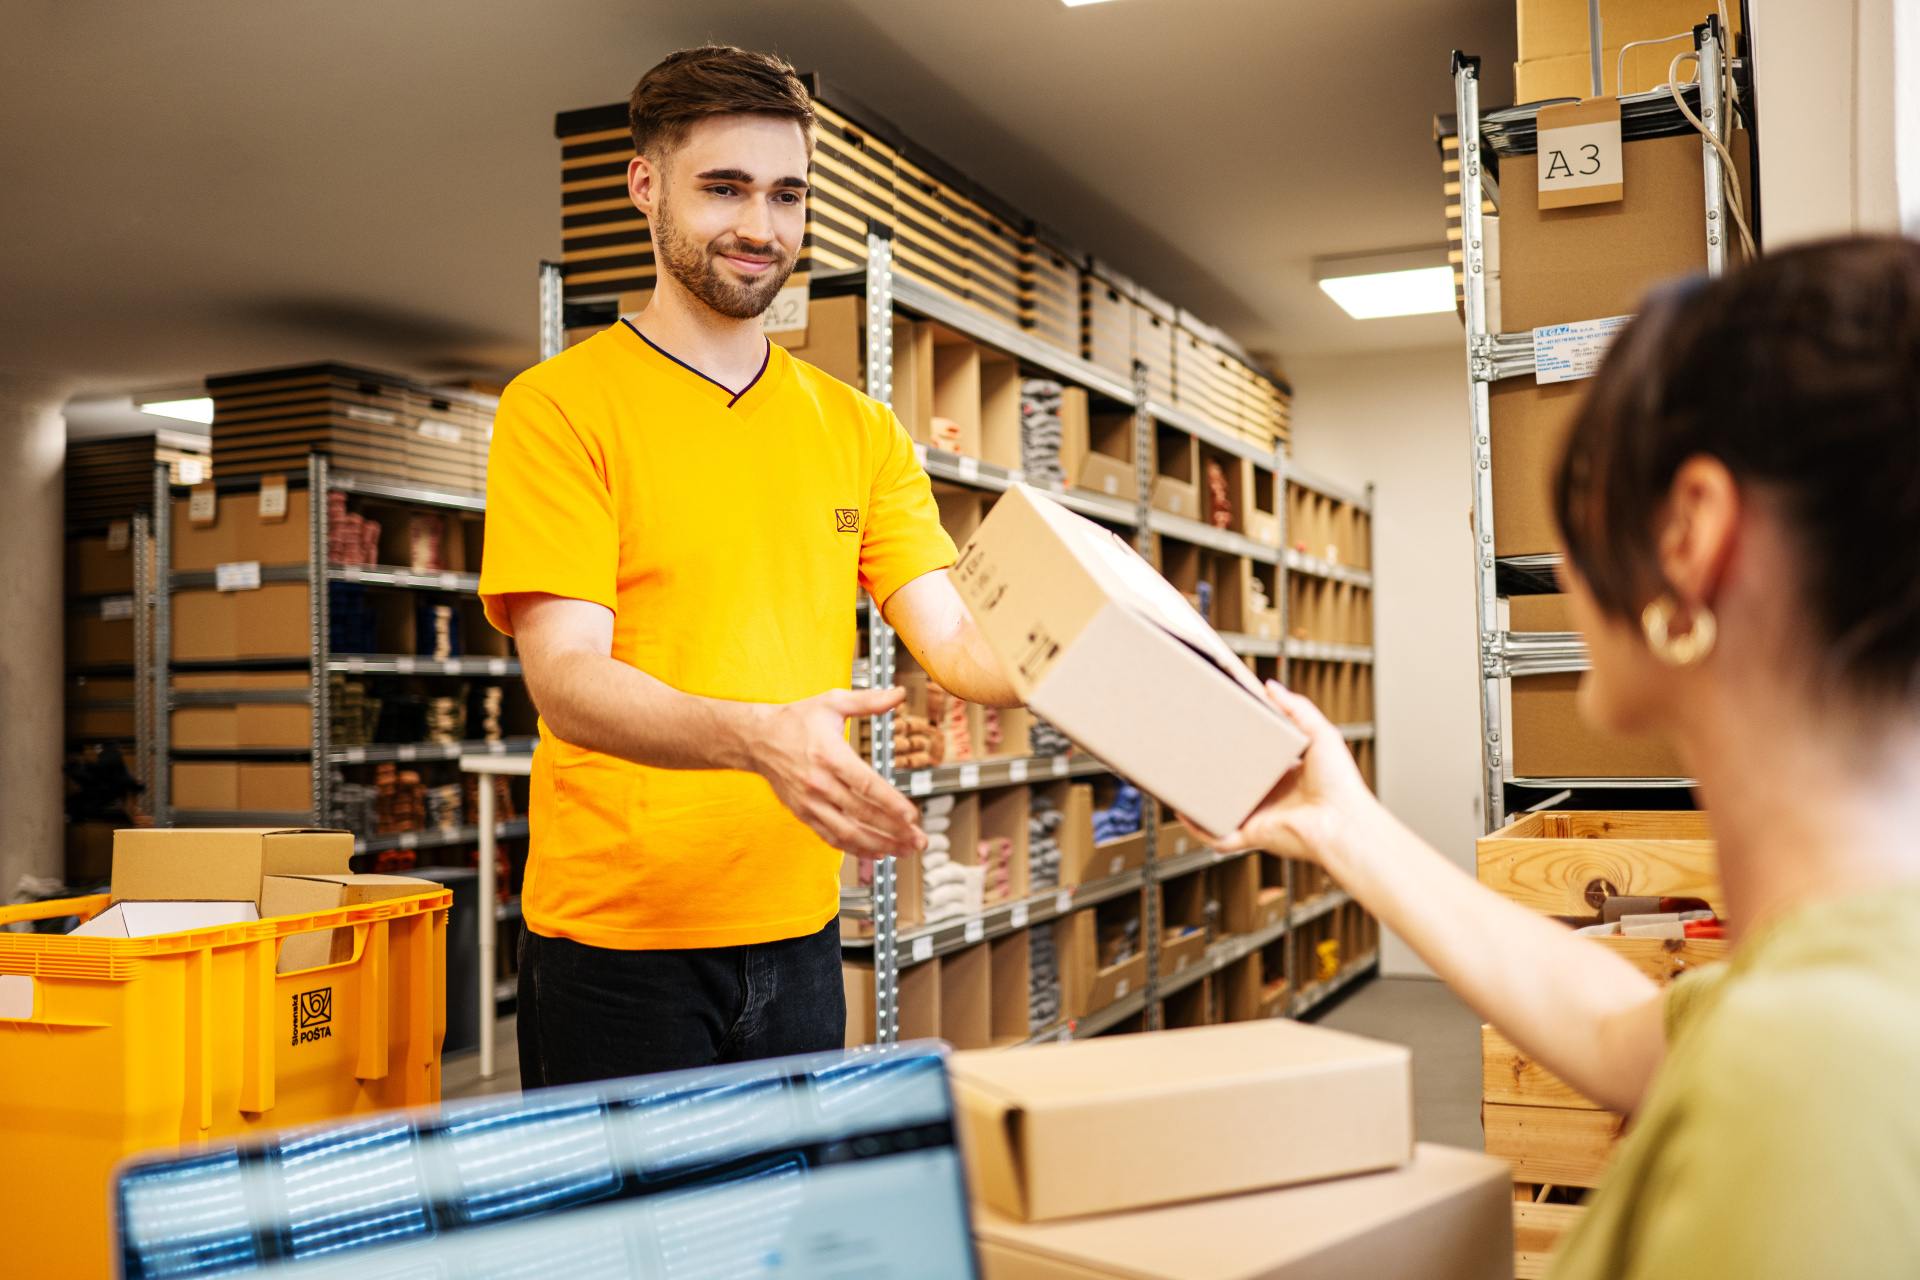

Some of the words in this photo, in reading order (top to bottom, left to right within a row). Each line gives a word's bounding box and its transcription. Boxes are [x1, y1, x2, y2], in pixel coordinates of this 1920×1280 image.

[1544, 143, 1601, 180] A3
[763, 299, 800, 327] A2
[291, 993, 299, 1047] Slovenská
[300, 1026, 332, 1044] POŠTA
